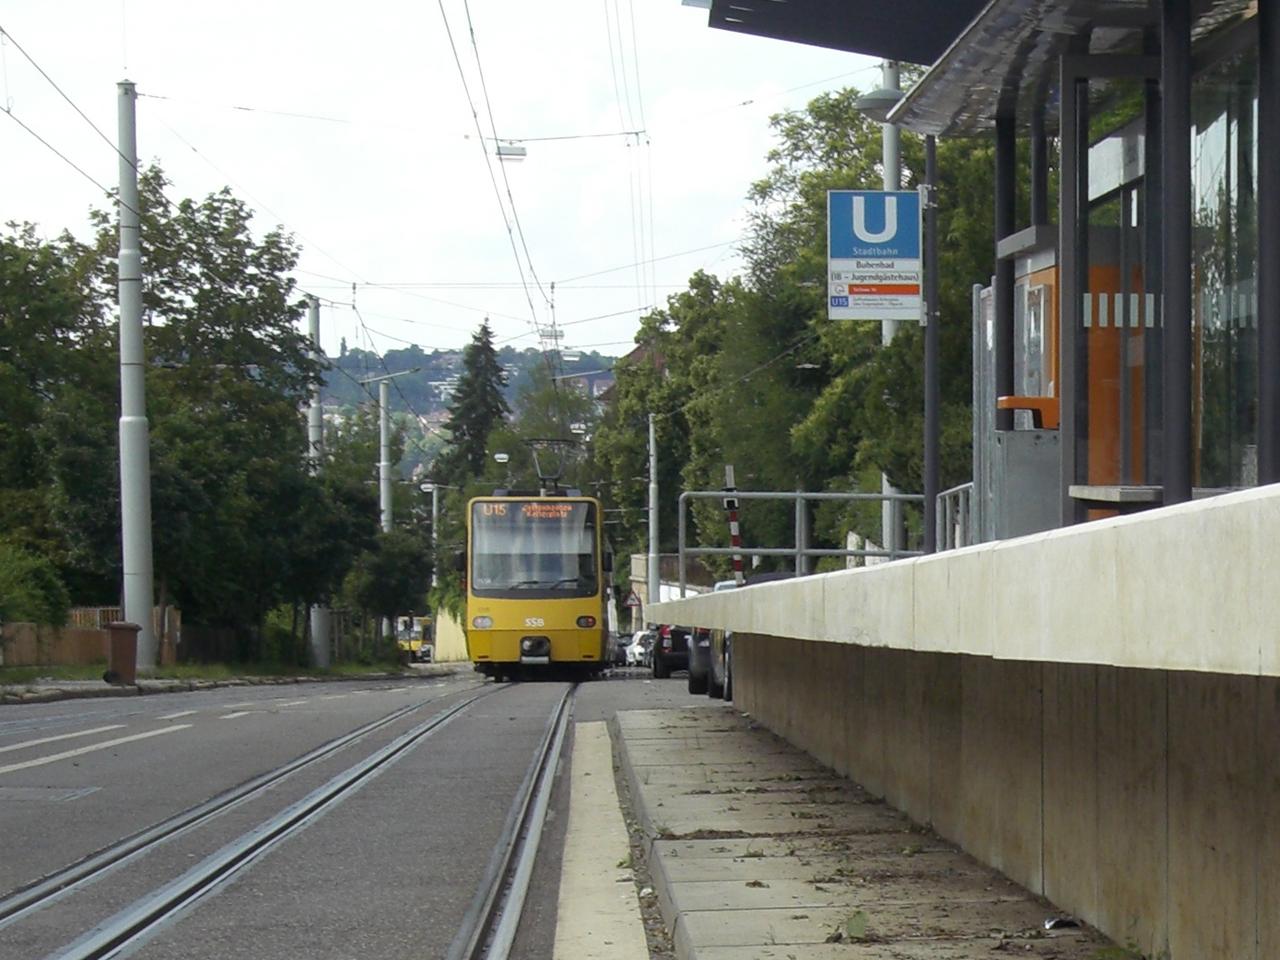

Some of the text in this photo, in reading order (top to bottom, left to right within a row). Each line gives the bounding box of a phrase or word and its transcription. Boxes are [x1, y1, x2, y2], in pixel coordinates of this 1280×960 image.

[852, 195, 898, 244] U
[852, 247, 899, 256] Stadtbahn
[856, 261, 895, 269] Bubenbad
[832, 297, 848, 306] U15
[482, 503, 506, 516] U15
